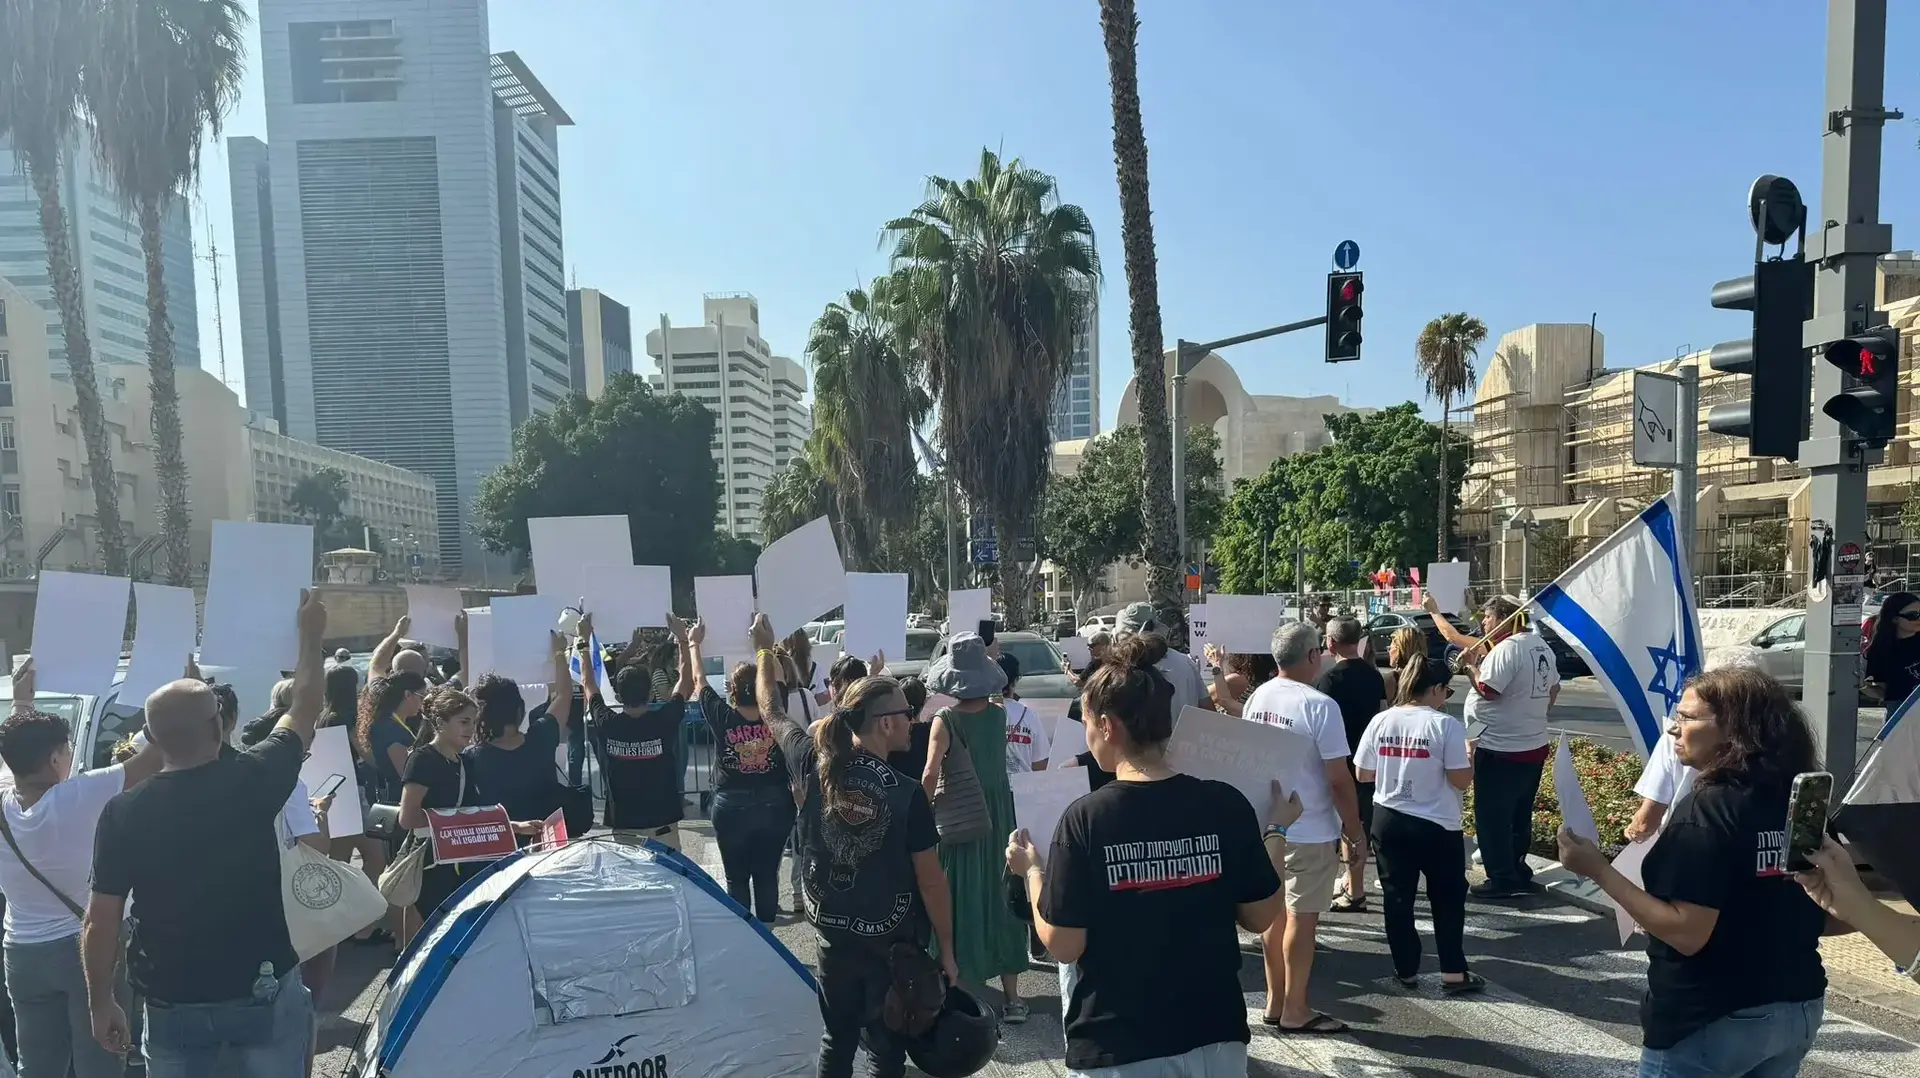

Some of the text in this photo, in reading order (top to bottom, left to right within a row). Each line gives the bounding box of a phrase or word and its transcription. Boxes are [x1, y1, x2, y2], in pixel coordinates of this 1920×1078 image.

[606, 743, 663, 757] FAMILIES FORUM
[1103, 834, 1220, 863] מטה המשפחות להחזרת
[833, 872, 851, 883] USA
[1106, 853, 1222, 886] החטופים והנעדרים
